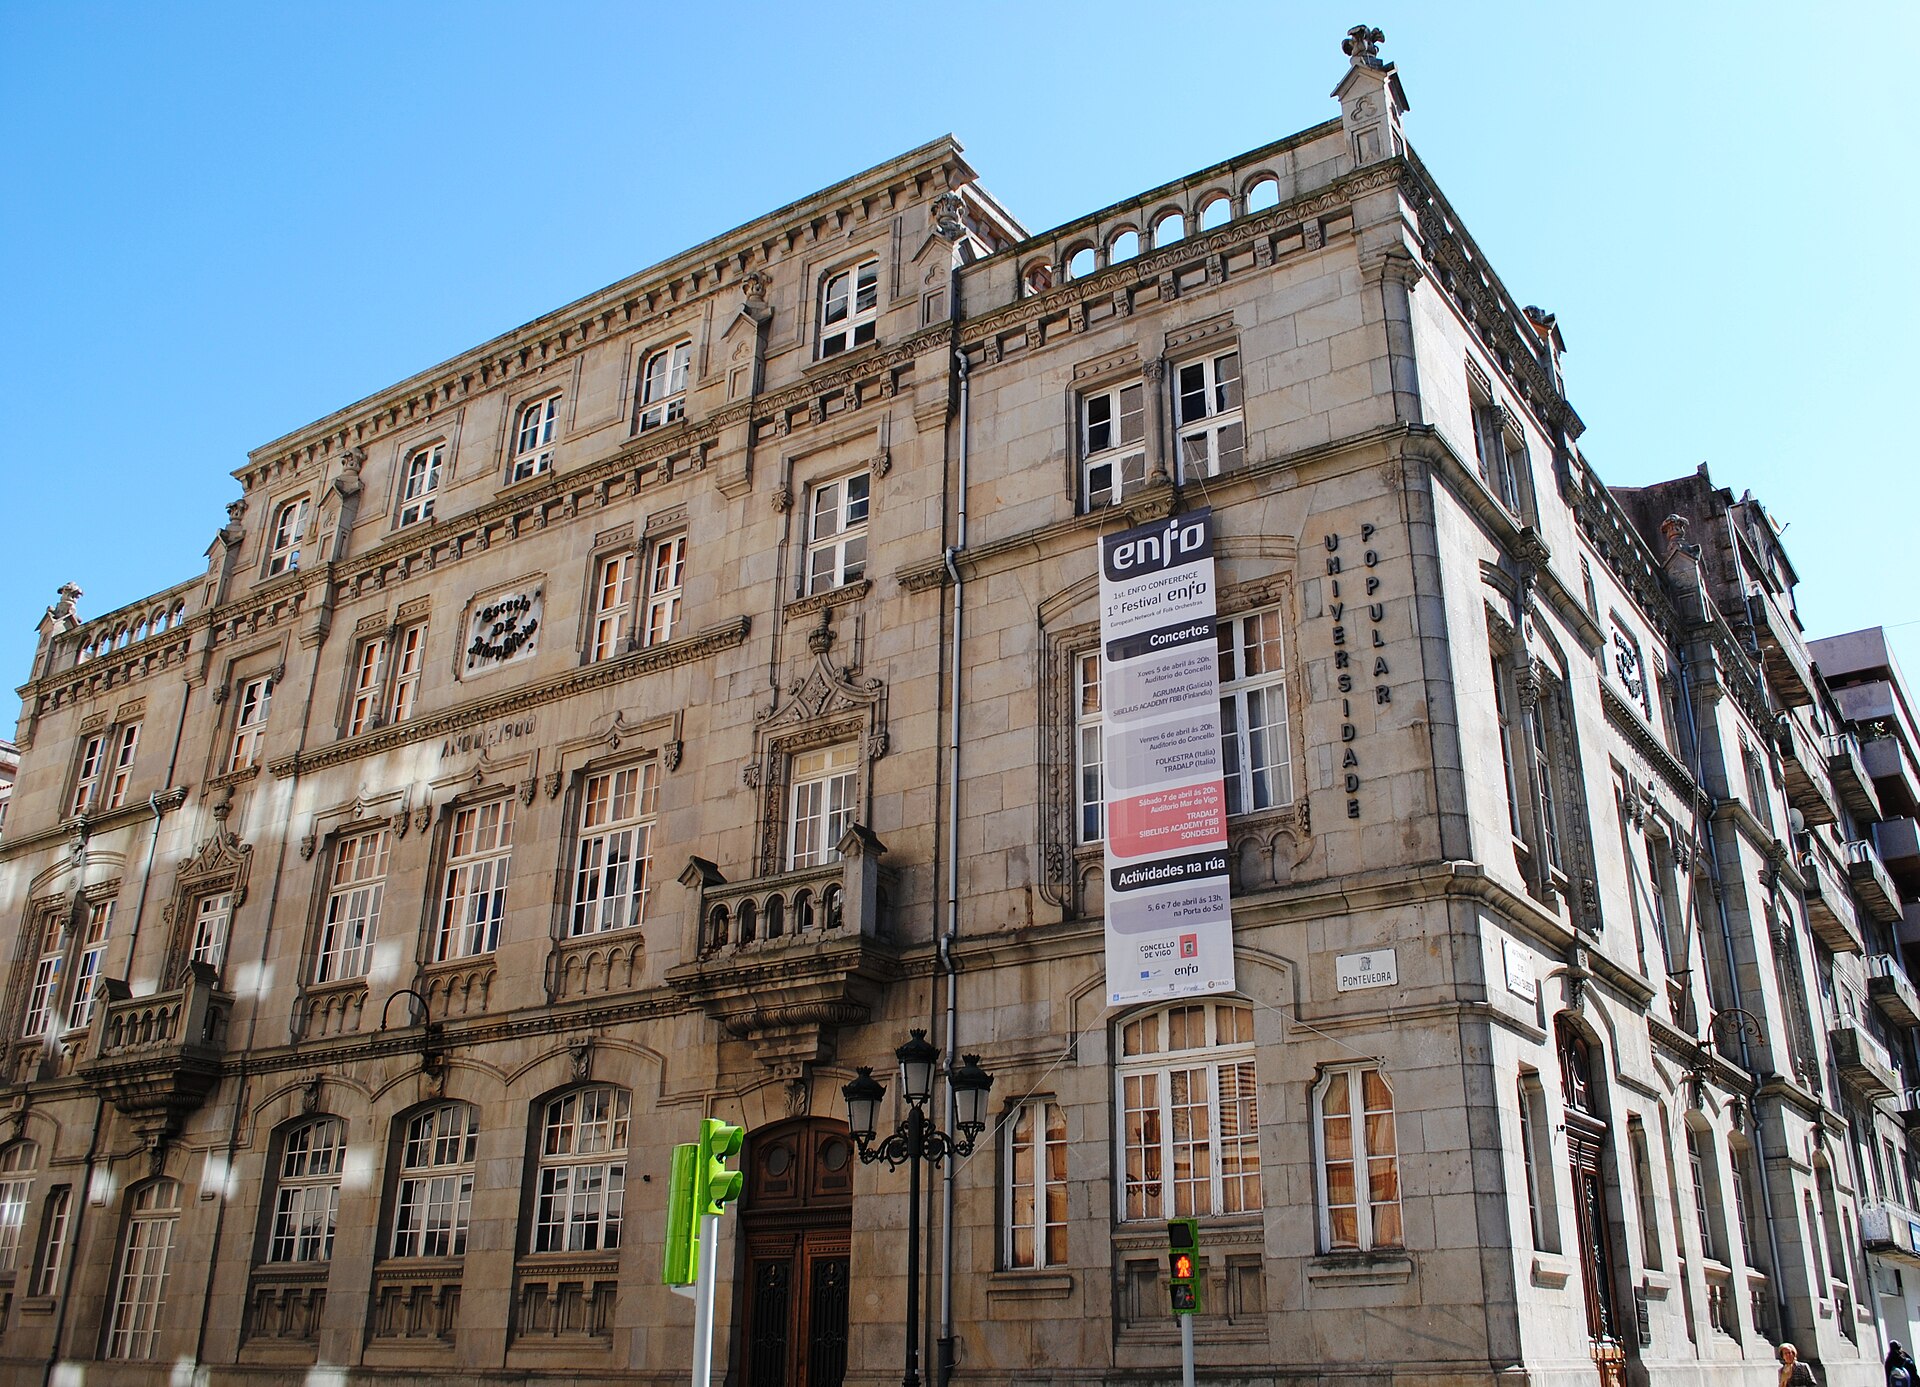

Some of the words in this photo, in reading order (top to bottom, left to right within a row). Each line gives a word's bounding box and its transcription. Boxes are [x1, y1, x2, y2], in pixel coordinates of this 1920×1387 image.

[1113, 519, 1204, 570] enfo
[1128, 585, 1146, 595] ENFO
[1148, 571, 1198, 589] CONFERENCE
[1122, 593, 1161, 613] Festival
[1168, 581, 1206, 601] enfo
[1111, 618, 1133, 627] European
[1135, 612, 1154, 621] Network
[1175, 600, 1202, 610] Orchestras
[1361, 523, 1390, 704] POPULAR
[1150, 625, 1209, 646] Concertos
[1138, 669, 1154, 677] Xoves
[1172, 660, 1186, 669] abril
[1197, 656, 1211, 664] 20h.
[1145, 674, 1172, 684] Auditorio
[1184, 664, 1211, 675] Concello
[1325, 534, 1359, 819] UNIVERSIDADE
[1153, 685, 1185, 698] AGRUMAR
[1186, 680, 1212, 691] (Galicia)
[1113, 705, 1138, 716] SIBELIUS
[1140, 697, 1169, 709] ACADEMY
[1183, 689, 1212, 701] (Finlandia)
[1140, 735, 1159, 743] Venres
[1176, 728, 1190, 736] abril
[1200, 723, 1214, 731] 20h.
[1150, 740, 1177, 750] Auditorio
[1188, 732, 1214, 742] Concello
[1156, 752, 1193, 765] FOLKESTRA
[1195, 748, 1215, 758] (Italia)
[1164, 761, 1194, 772] TRADALP
[1195, 757, 1216, 767] (Italia)
[1139, 797, 1161, 806] Sábado
[1178, 790, 1192, 799] abril
[1151, 803, 1178, 813] Auditorio
[1204, 796, 1217, 804] Vigo
[1187, 809, 1218, 819] TRADALP
[1139, 827, 1169, 838] SIBELIUS
[1171, 821, 1203, 832] ACADEMY
[1181, 827, 1219, 839] SONDESEU
[1119, 865, 1183, 886] Actividades
[1187, 862, 1201, 873] na
[1205, 857, 1225, 870] rúa
[1173, 899, 1180, 907] de
[1182, 898, 1197, 906] abril
[1208, 894, 1223, 903] 13h.
[1183, 908, 1200, 916] Porta
[1140, 941, 1175, 952] CONCELLO
[1156, 949, 1171, 957] VIGO
[1175, 964, 1198, 976] enfo
[1342, 972, 1391, 986] PONTEVEDRA
